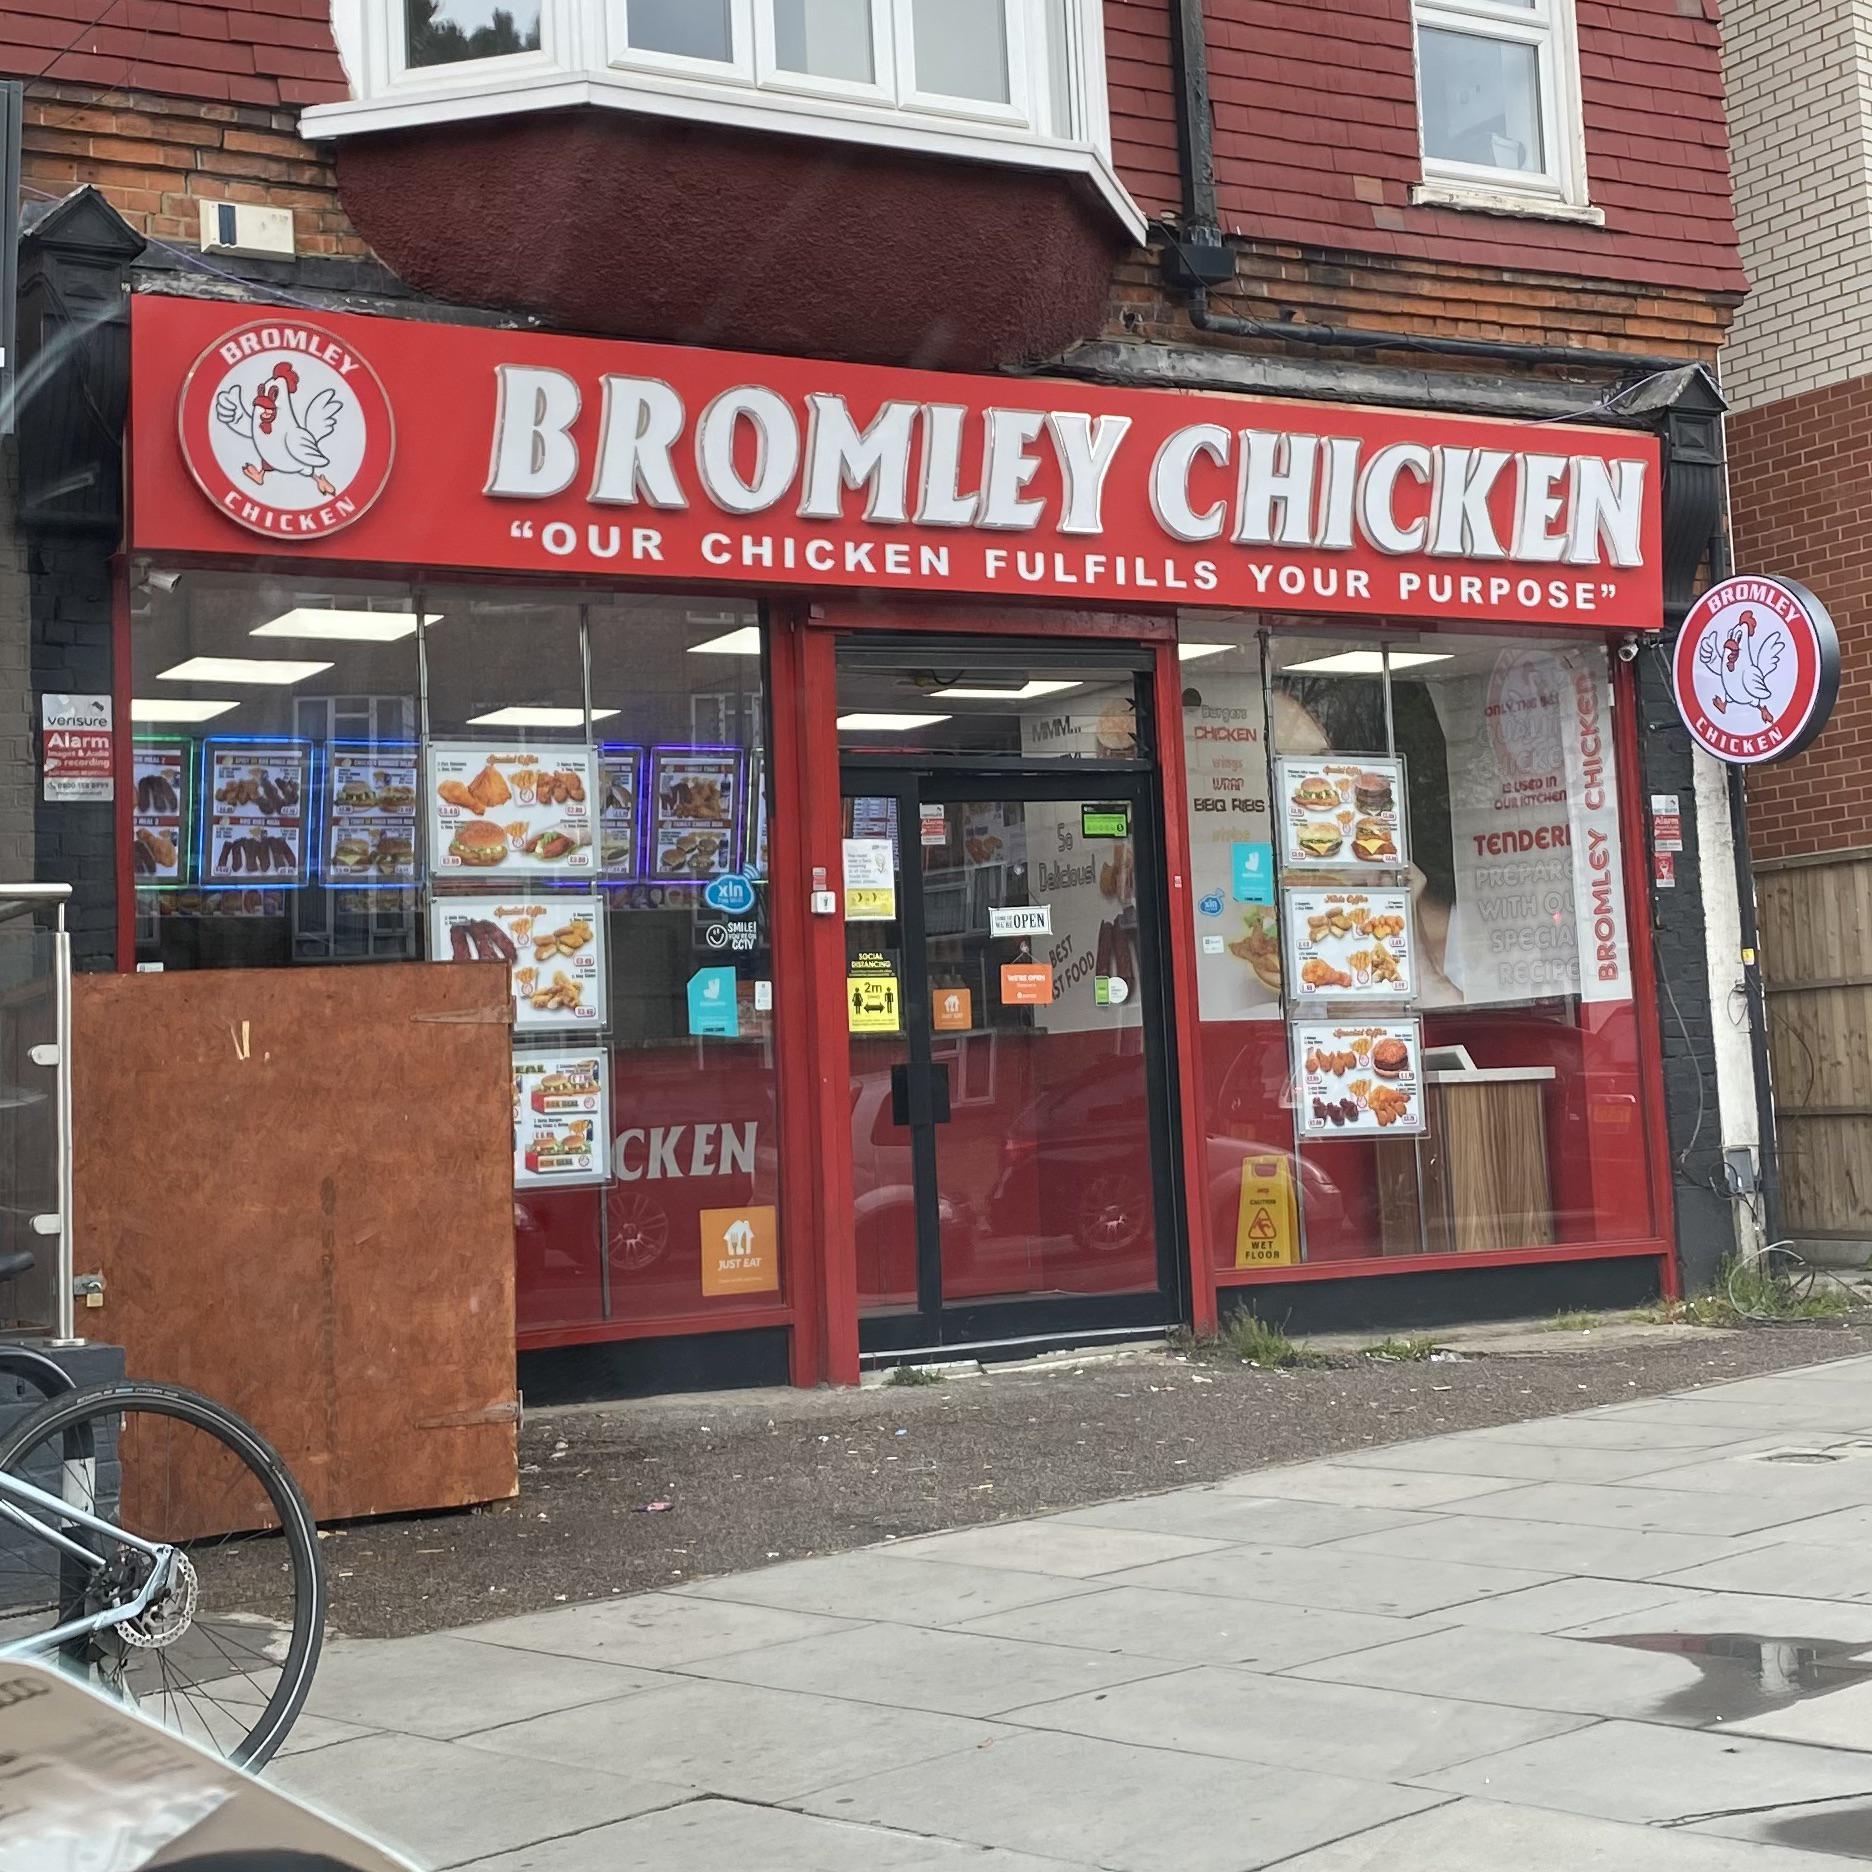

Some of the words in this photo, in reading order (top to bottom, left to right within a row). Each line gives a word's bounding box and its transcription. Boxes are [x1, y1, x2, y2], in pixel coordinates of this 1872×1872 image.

[219, 328, 360, 376] BROMLEY
[482, 363, 1132, 534] BROMLEY
[1149, 422, 1649, 569] CHICKEN
[223, 490, 357, 532] CHICKEN
[701, 532, 950, 577] CHICKEN
[984, 548, 1218, 590] FULFILLS
[1247, 563, 1372, 600] YOUR
[1706, 583, 1801, 624] BROMLEY
[1201, 704, 1248, 723] Burgers
[1484, 702, 1515, 717] ONLY
[47, 716, 108, 727] verisure
[48, 732, 109, 748] Alarm
[1193, 726, 1258, 742] CHICKEN
[1575, 670, 1606, 811] CHICKEN
[1694, 716, 1784, 754] CHICKEN
[64, 757, 110, 769] recording
[1515, 778, 1543, 792] USED
[1546, 775, 1557, 788] IN
[1193, 798, 1227, 812] BBQ
[1231, 798, 1266, 813] RIBS
[1494, 797, 1518, 810] OUR
[1520, 789, 1567, 807] KITCHEN
[1655, 816, 1679, 825] Alarm
[718, 881, 743, 897] xln
[1477, 893, 1537, 922] WITH
[1588, 827, 1619, 981] BROMLEY
[727, 921, 757, 933] SMILE!
[1013, 912, 1045, 928] OPEN
[731, 938, 755, 950] CCTV
[1049, 934, 1073, 969] BEST
[851, 960, 892, 969] DISTANCING
[858, 952, 884, 961] SOCIAL
[1064, 950, 1095, 988] FOOD
[863, 981, 883, 993] 2m
[612, 1121, 758, 1181] CKEN
[1251, 1240, 1274, 1249] WET
[1245, 1250, 1280, 1260] FLOOR
[717, 1258, 742, 1271] JUST
[743, 1257, 763, 1268] EAT
